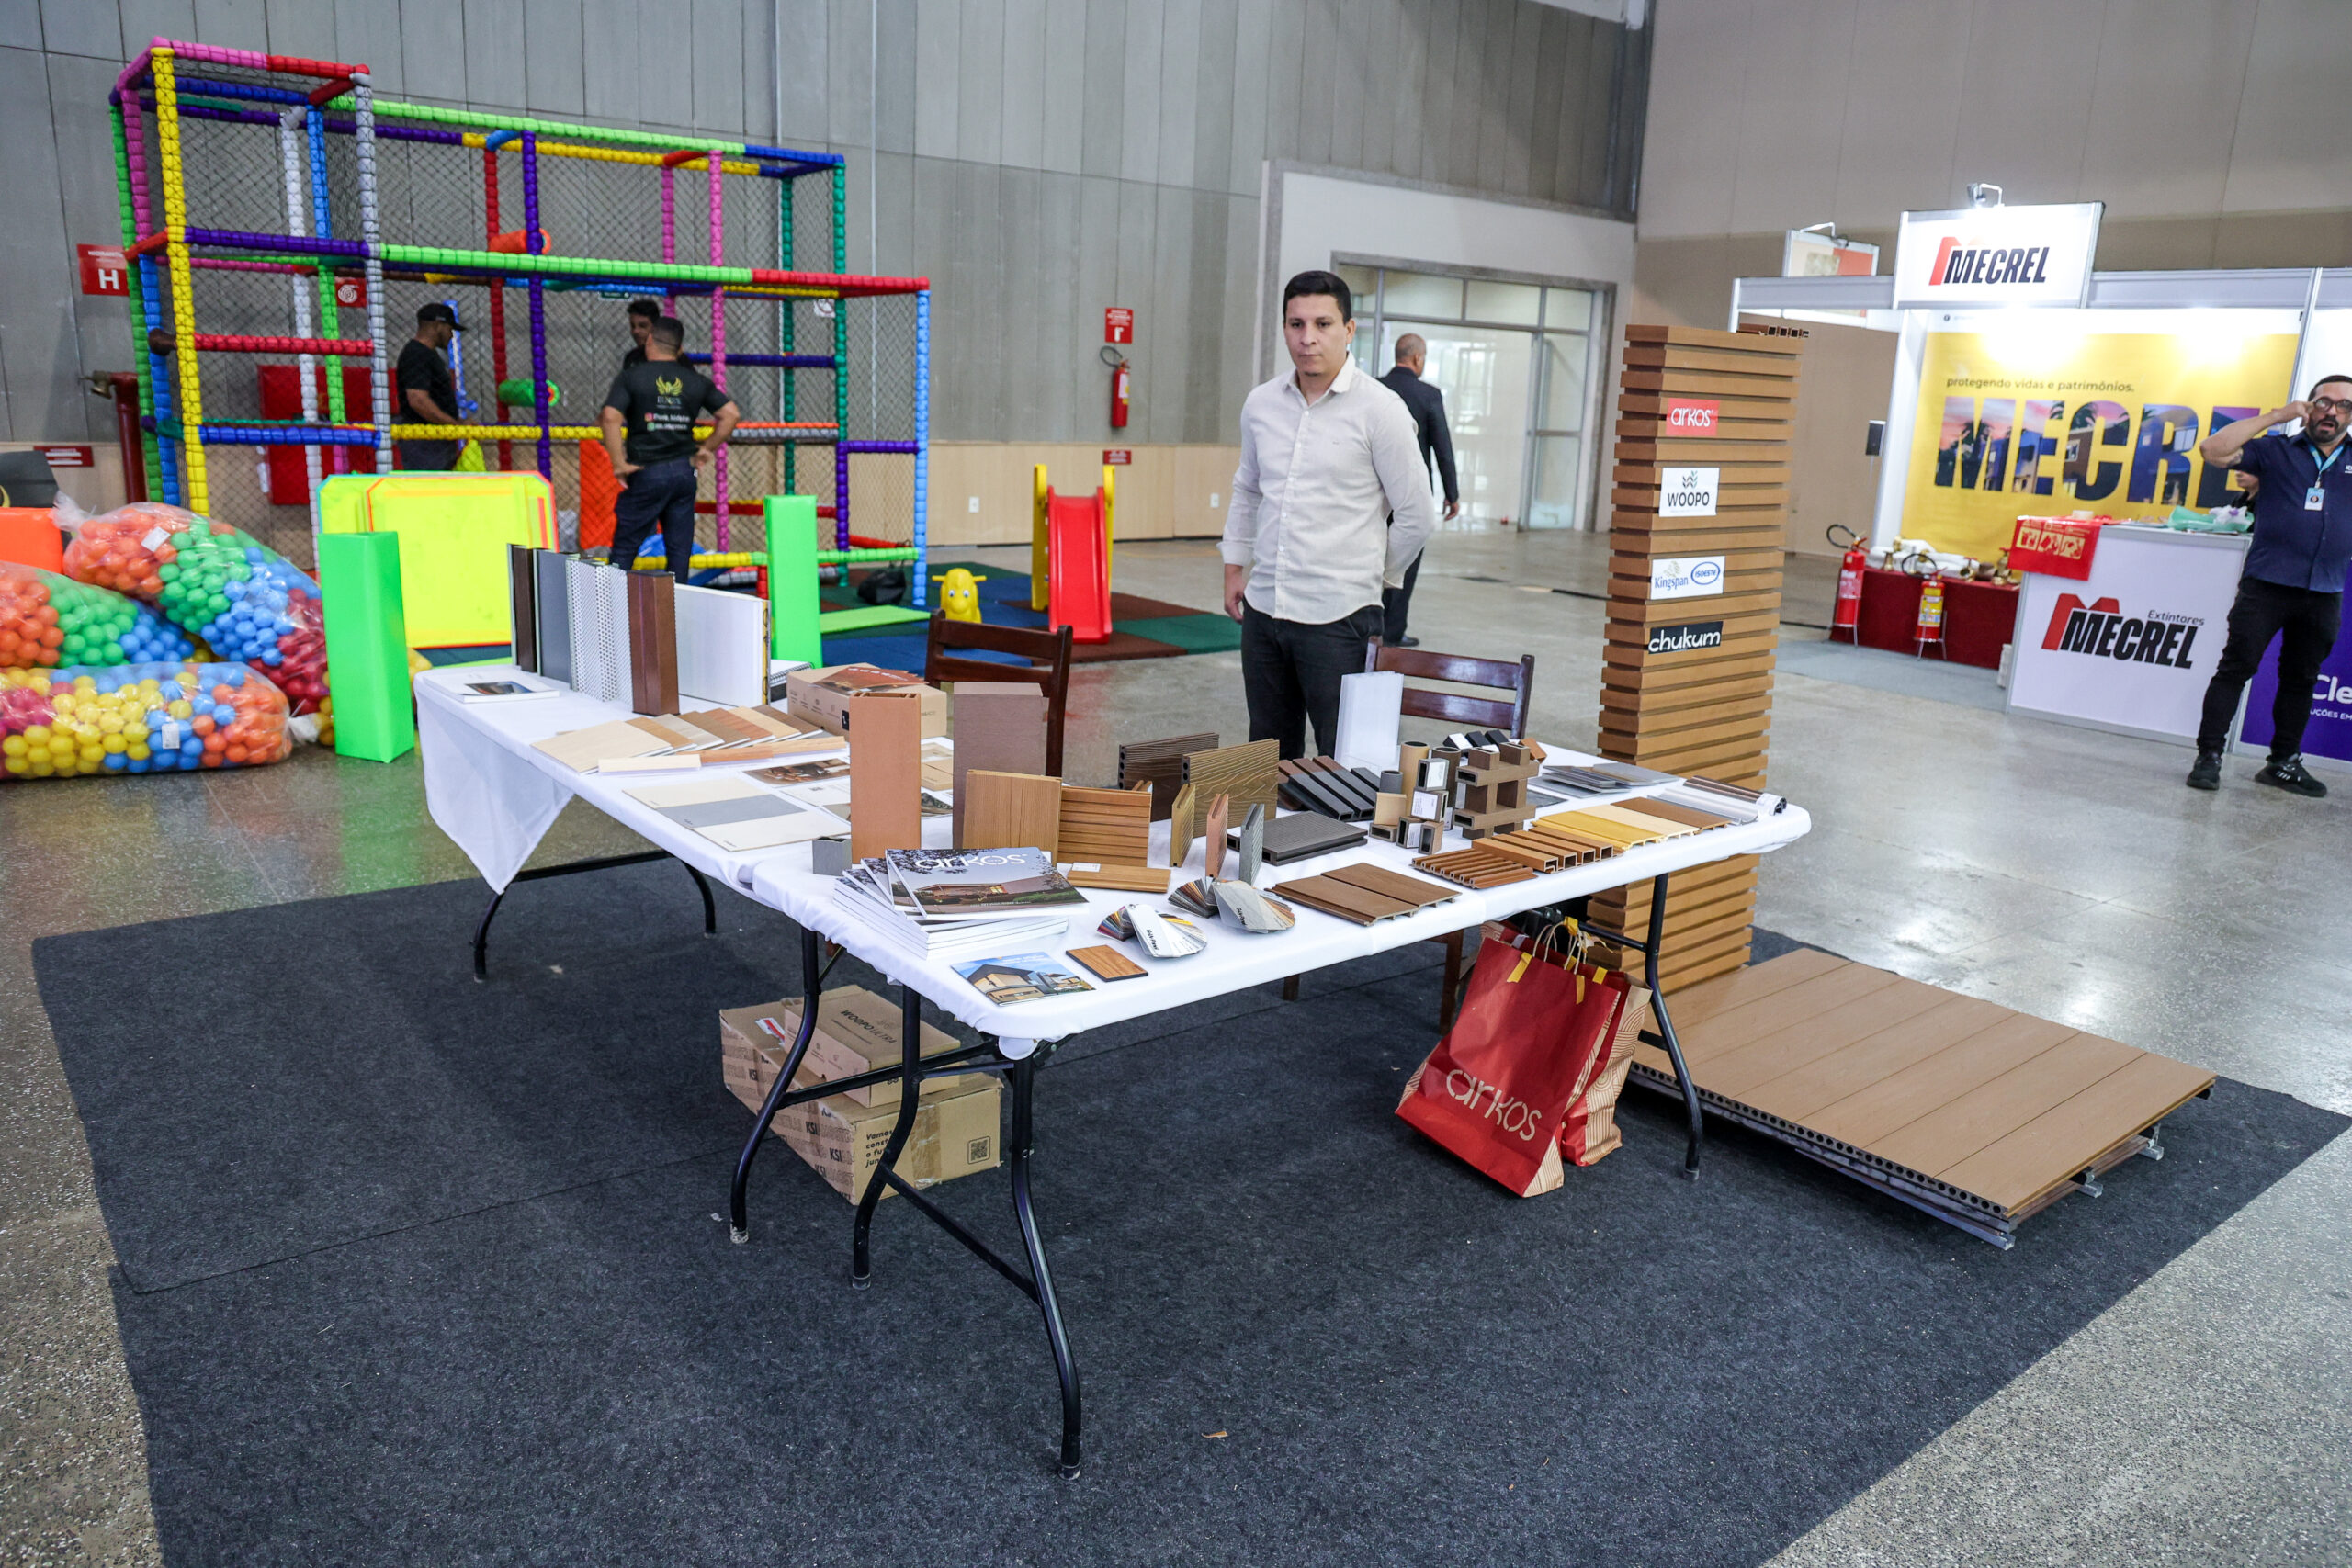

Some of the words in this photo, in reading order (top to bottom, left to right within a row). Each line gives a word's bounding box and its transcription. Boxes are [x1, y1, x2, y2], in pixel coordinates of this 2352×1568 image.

[1943, 247, 2050, 284] MECREL
[98, 268, 119, 290] H
[1946, 378, 2011, 389] protegendo
[2015, 379, 2044, 389] vidas
[2058, 381, 2135, 392] patrimônios.
[1671, 407, 1711, 427] arkos
[1935, 396, 2284, 508] MECRE
[1668, 492, 1710, 507] WOOPO
[1655, 577, 1689, 591] Kingspan
[2148, 610, 2205, 626] Extintores
[1648, 627, 1721, 652] chukum
[2060, 611, 2198, 669] MECREL
[915, 853, 1026, 869] arkos
[841, 1010, 874, 1030] WOOPO
[1446, 1069, 1542, 1141] arkos
[806, 1121, 820, 1135] KSI
[829, 1147, 842, 1163] KSI
